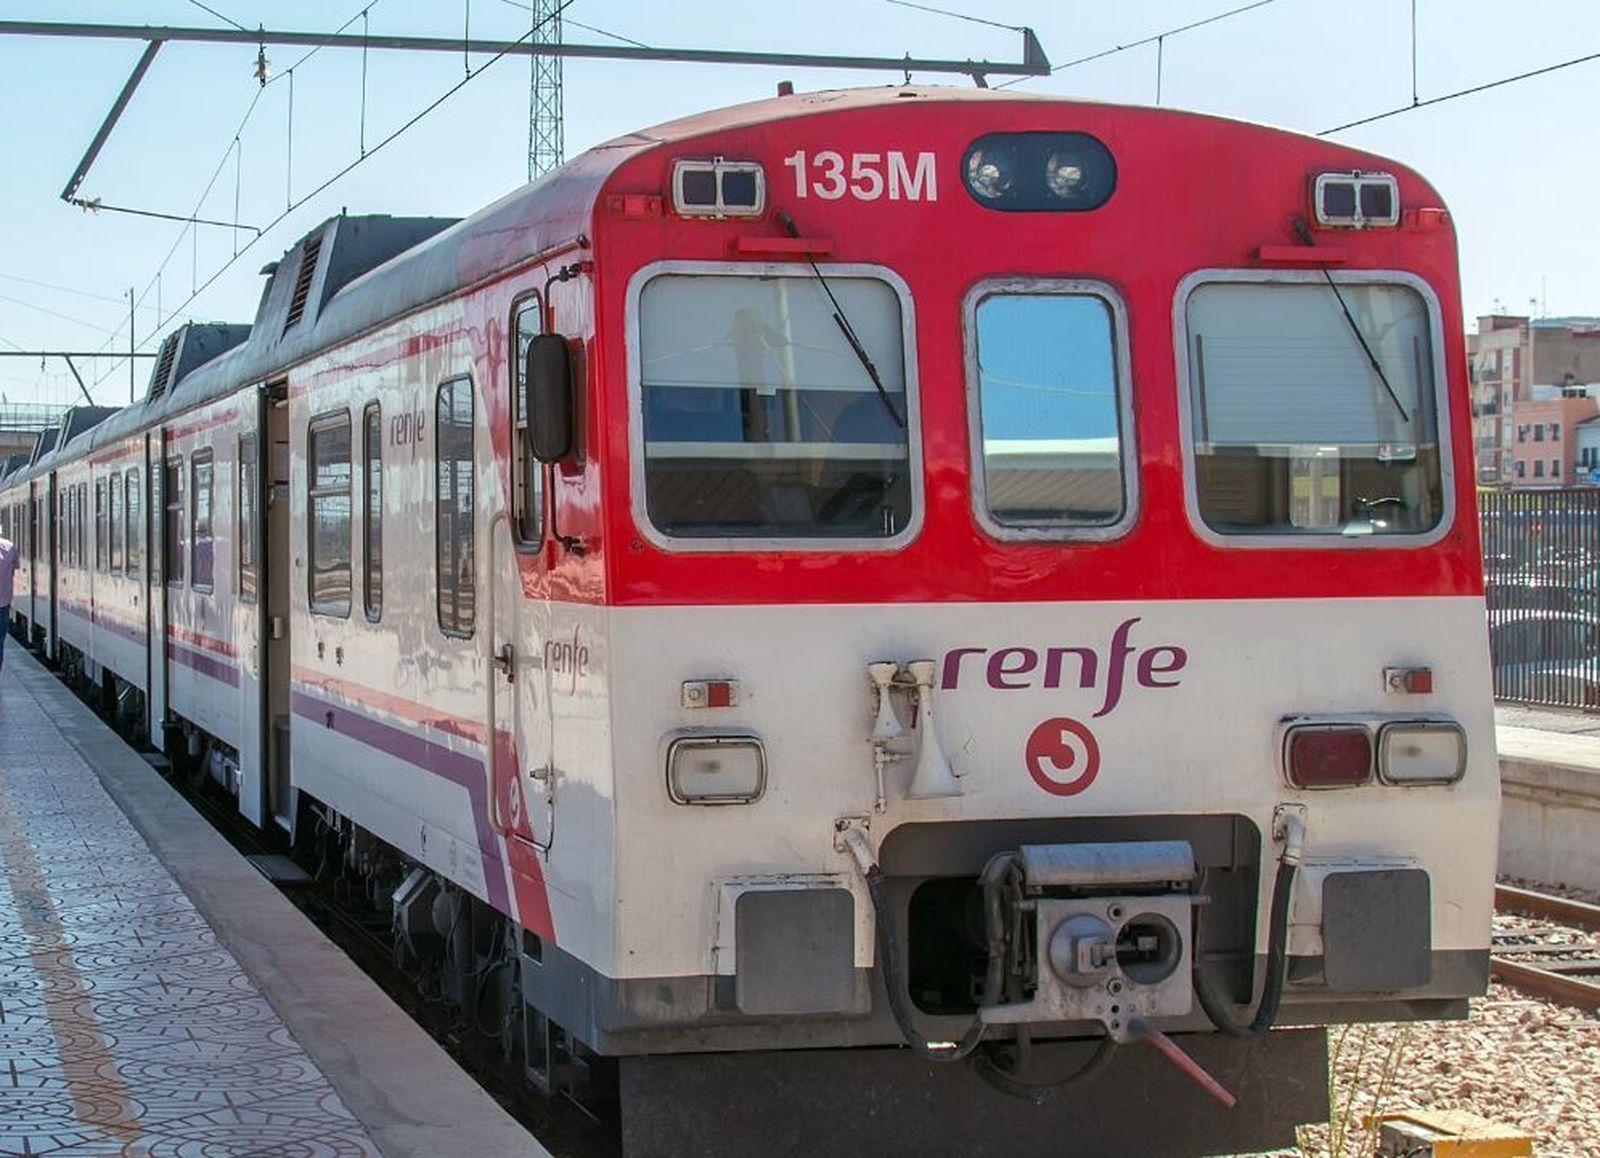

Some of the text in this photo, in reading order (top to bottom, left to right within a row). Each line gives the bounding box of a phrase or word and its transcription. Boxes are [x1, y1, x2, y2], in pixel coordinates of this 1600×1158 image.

[784, 150, 938, 202] 135M
[390, 396, 425, 460] renfe
[544, 624, 589, 695] renfe
[940, 617, 1188, 717] renfe
